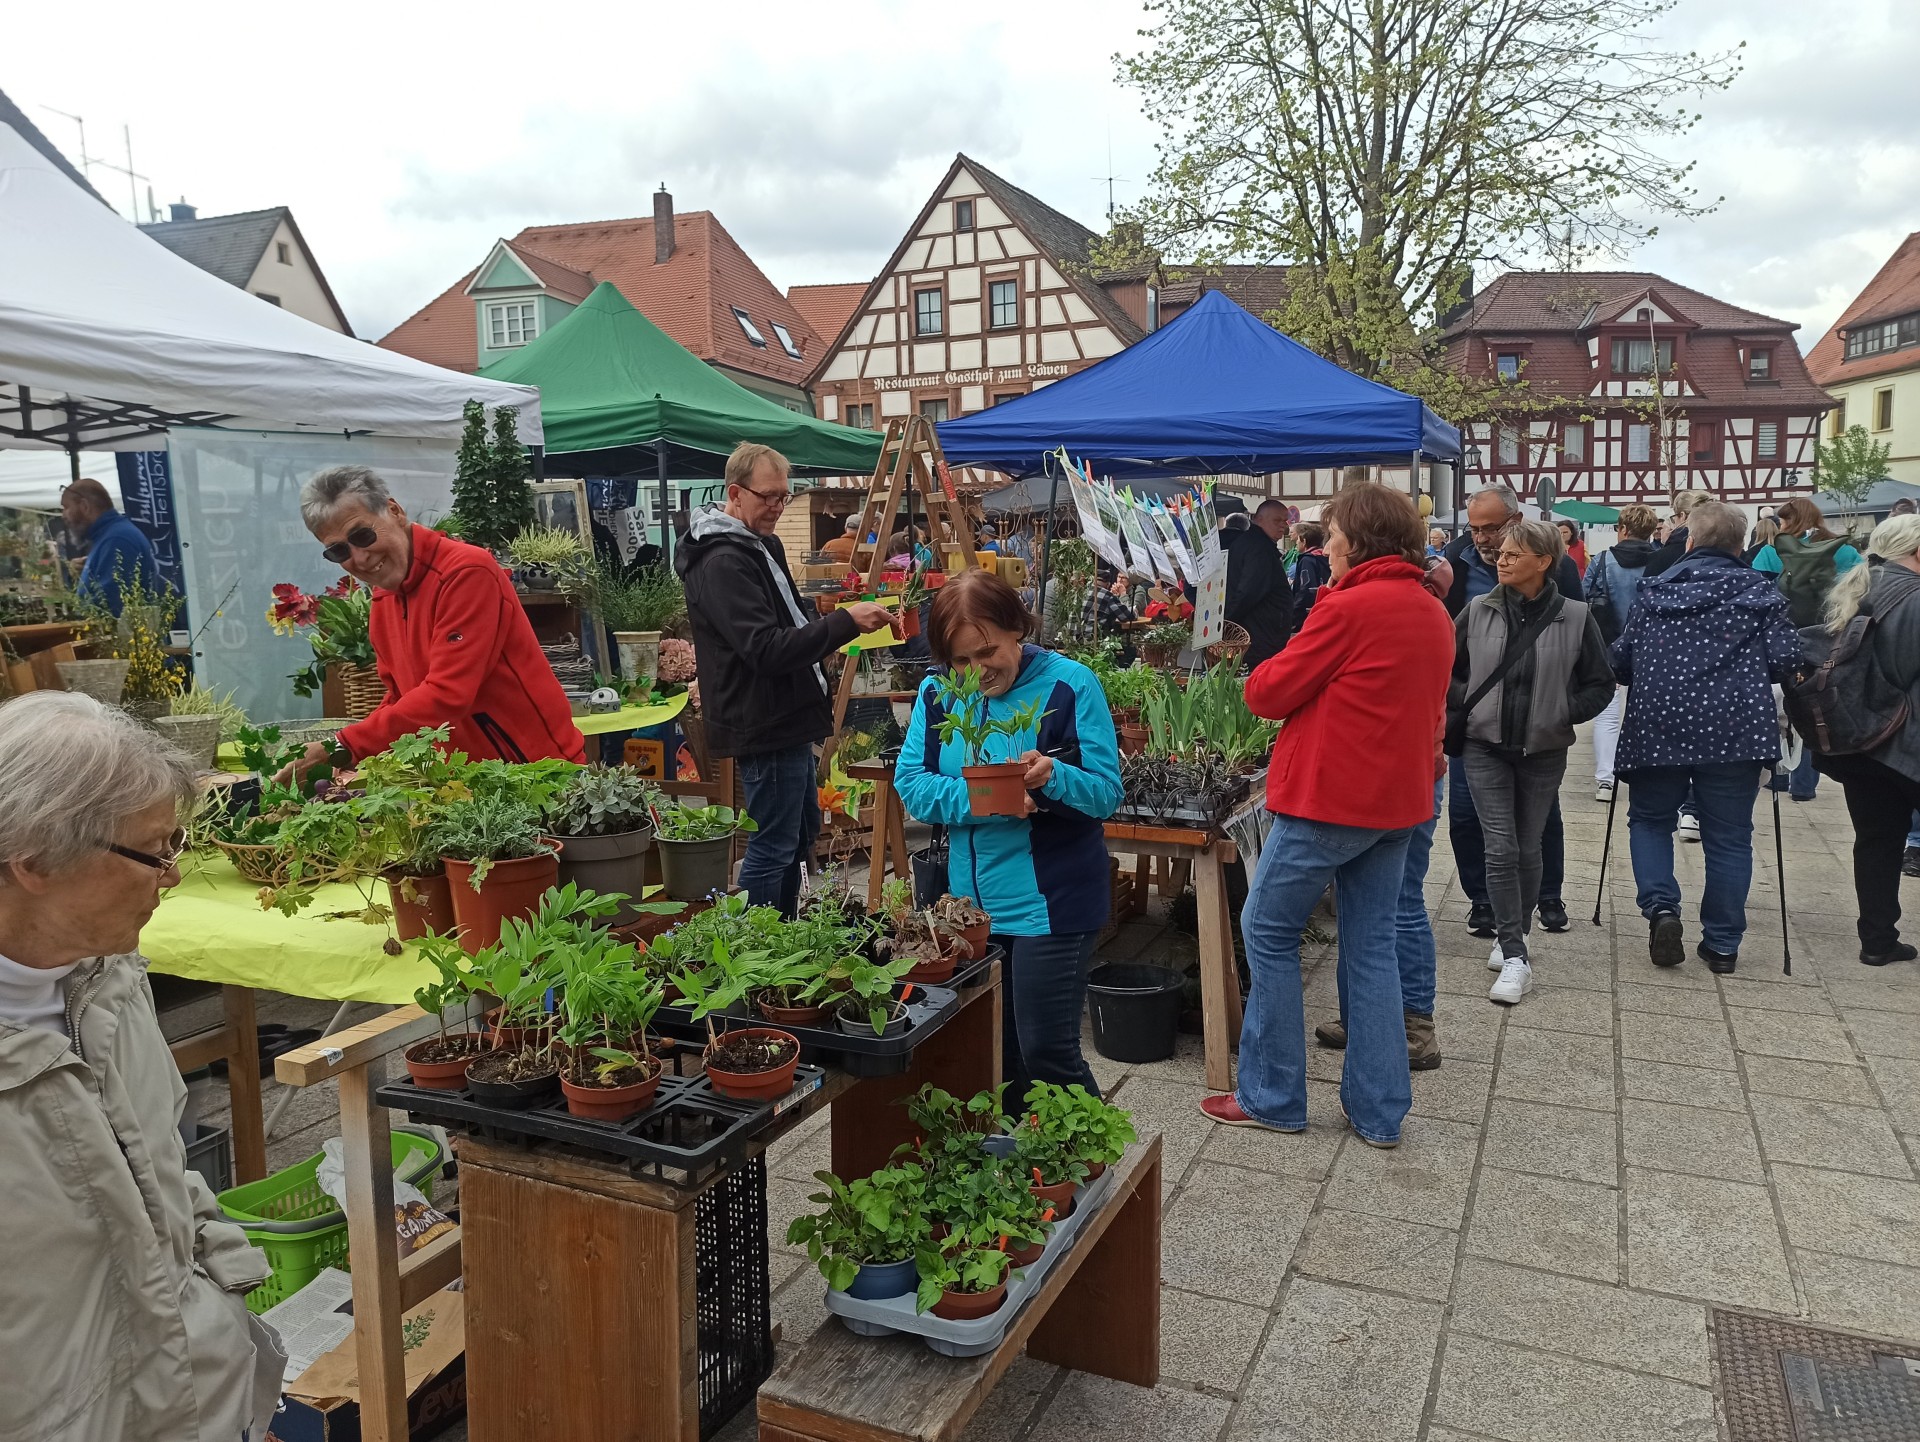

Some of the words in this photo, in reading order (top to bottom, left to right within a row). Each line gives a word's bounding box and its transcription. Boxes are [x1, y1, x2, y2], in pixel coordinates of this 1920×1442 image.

[873, 374, 941, 391] Restaurant
[944, 368, 994, 386] Gasthof
[997, 368, 1023, 384] zum
[1027, 363, 1069, 378] Löwen
